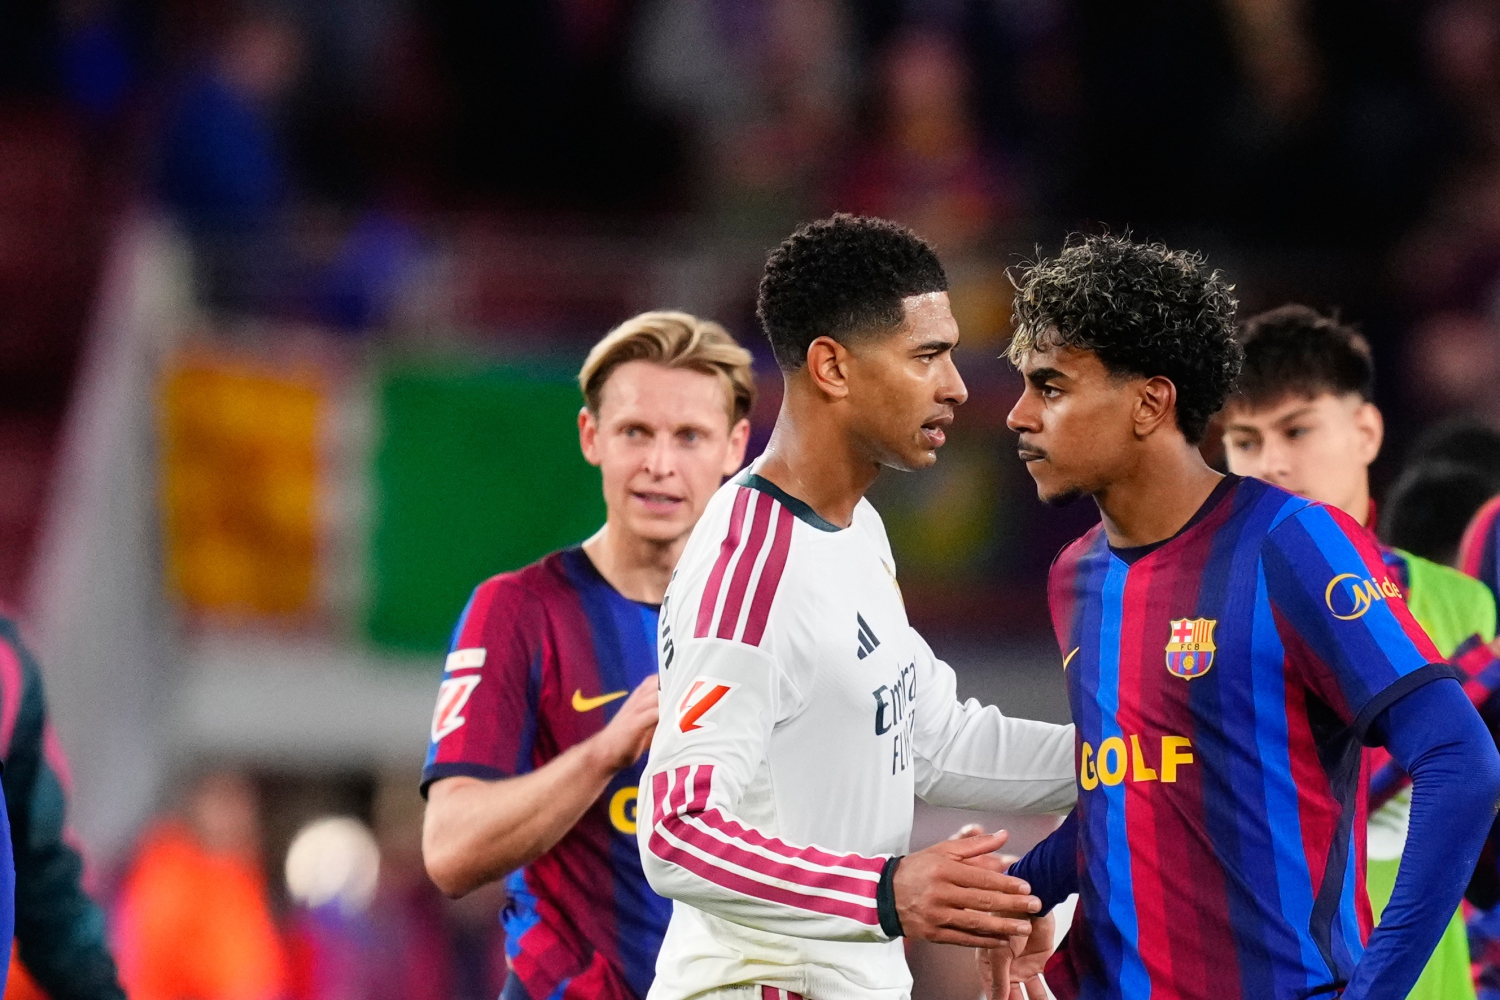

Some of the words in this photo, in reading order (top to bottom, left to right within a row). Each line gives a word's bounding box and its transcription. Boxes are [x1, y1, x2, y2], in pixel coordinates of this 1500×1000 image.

[1330, 573, 1402, 620] Mide
[1180, 643, 1200, 651] FCB
[1081, 734, 1194, 791] GOLF
